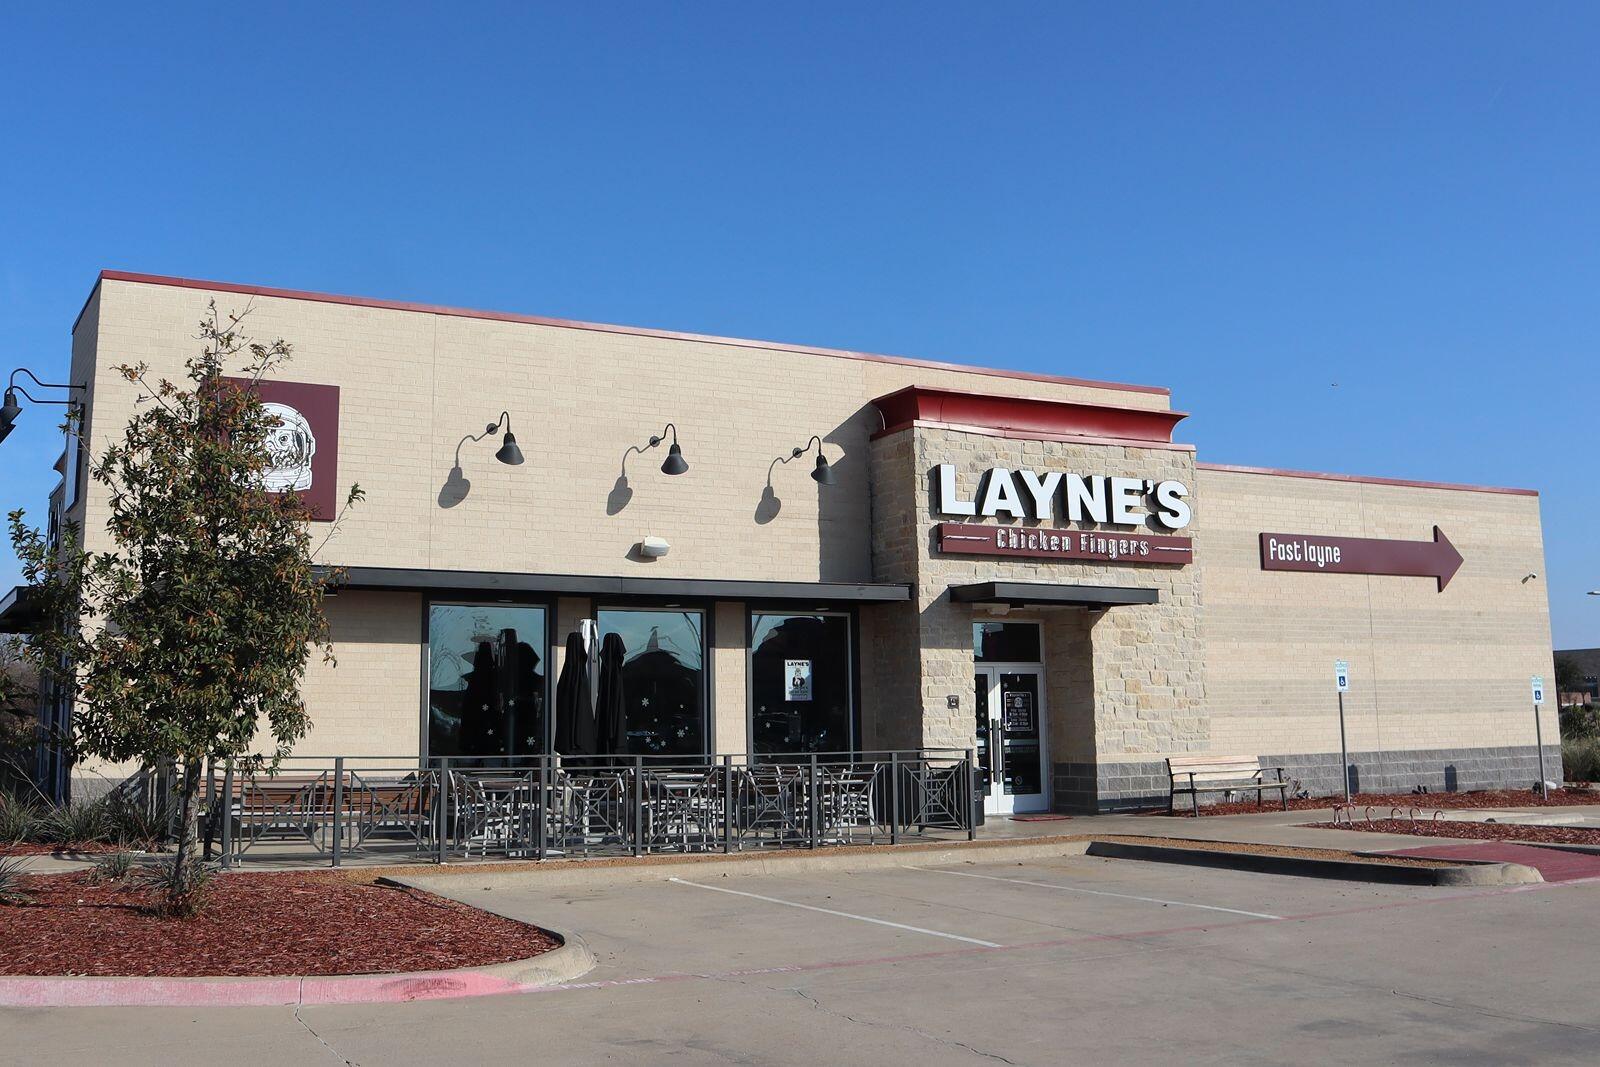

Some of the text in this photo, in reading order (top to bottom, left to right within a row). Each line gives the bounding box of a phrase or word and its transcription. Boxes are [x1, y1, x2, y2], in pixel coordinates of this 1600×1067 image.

[938, 464, 1191, 529] LAYNE'S
[997, 528, 1149, 560] Chicken Fingers
[1303, 540, 1341, 568] layne
